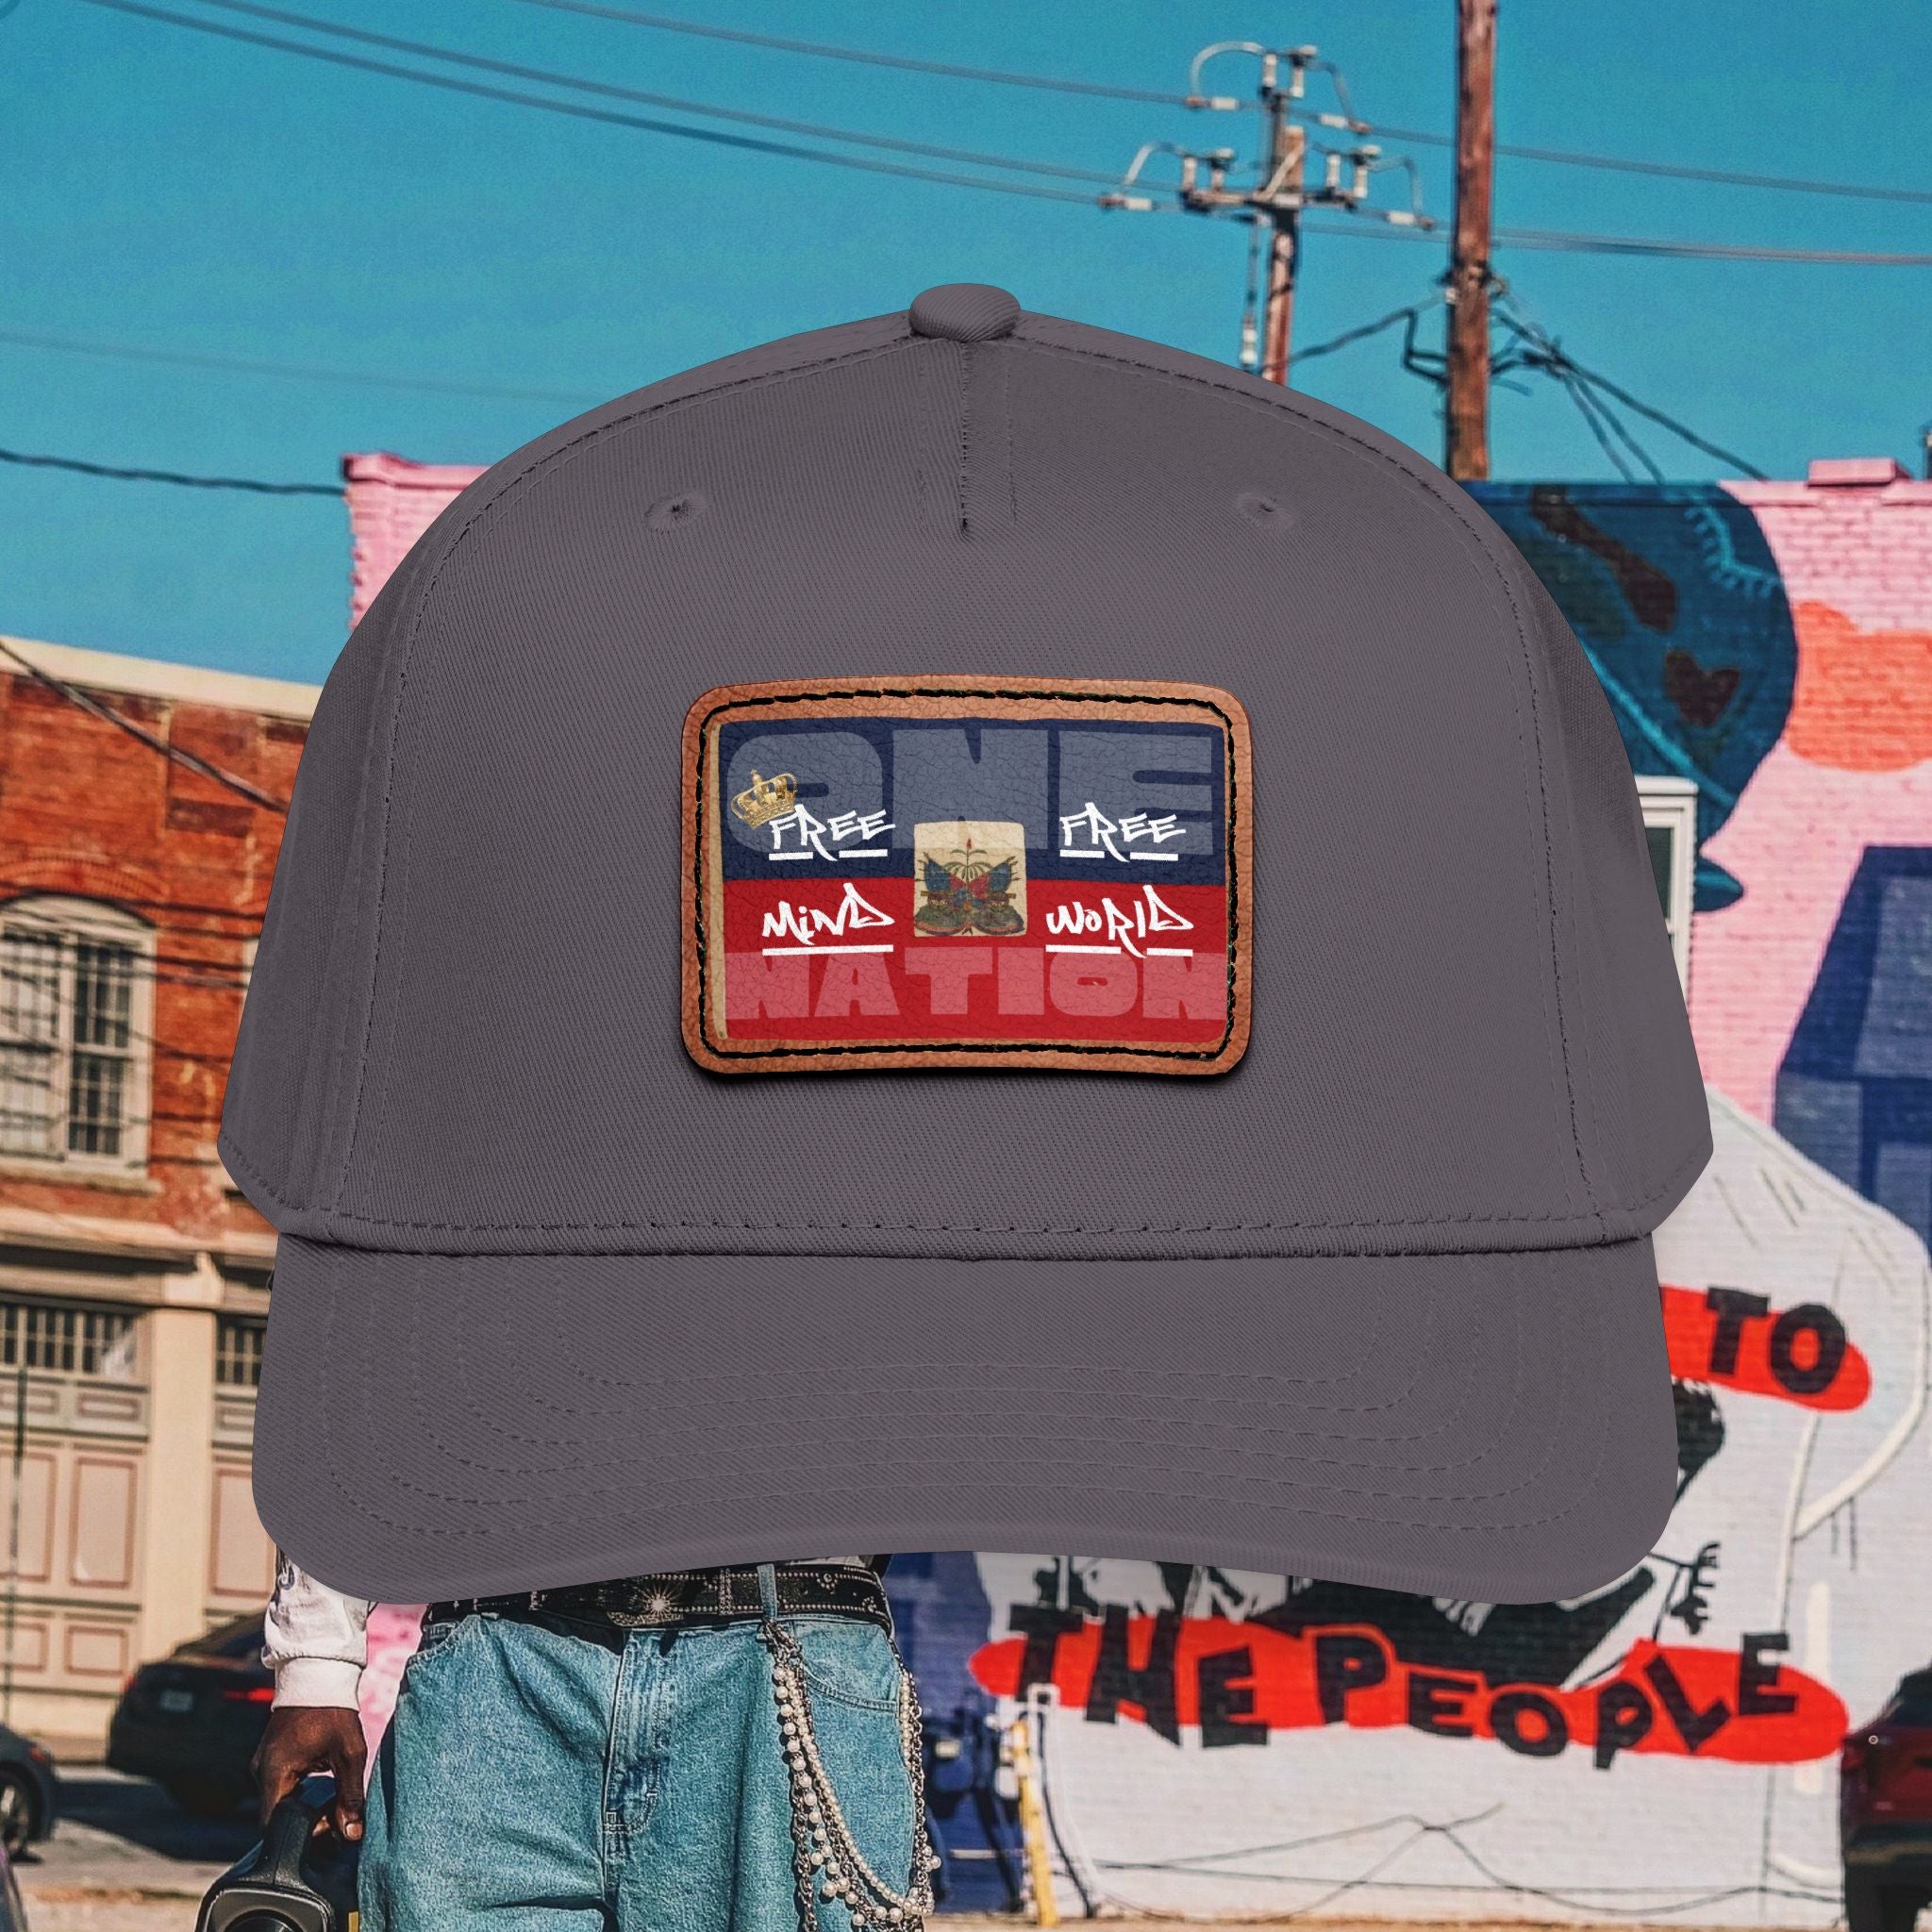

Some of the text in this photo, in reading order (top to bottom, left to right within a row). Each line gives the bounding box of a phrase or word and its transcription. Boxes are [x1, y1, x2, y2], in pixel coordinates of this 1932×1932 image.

[726, 727, 1213, 856] ONE
[769, 804, 896, 861] FREE
[1059, 802, 1187, 862] FREE
[724, 946, 1225, 1021] NATION
[1706, 1286, 1847, 1394] TO
[1008, 1603, 1799, 1769] THE PEOPLE
